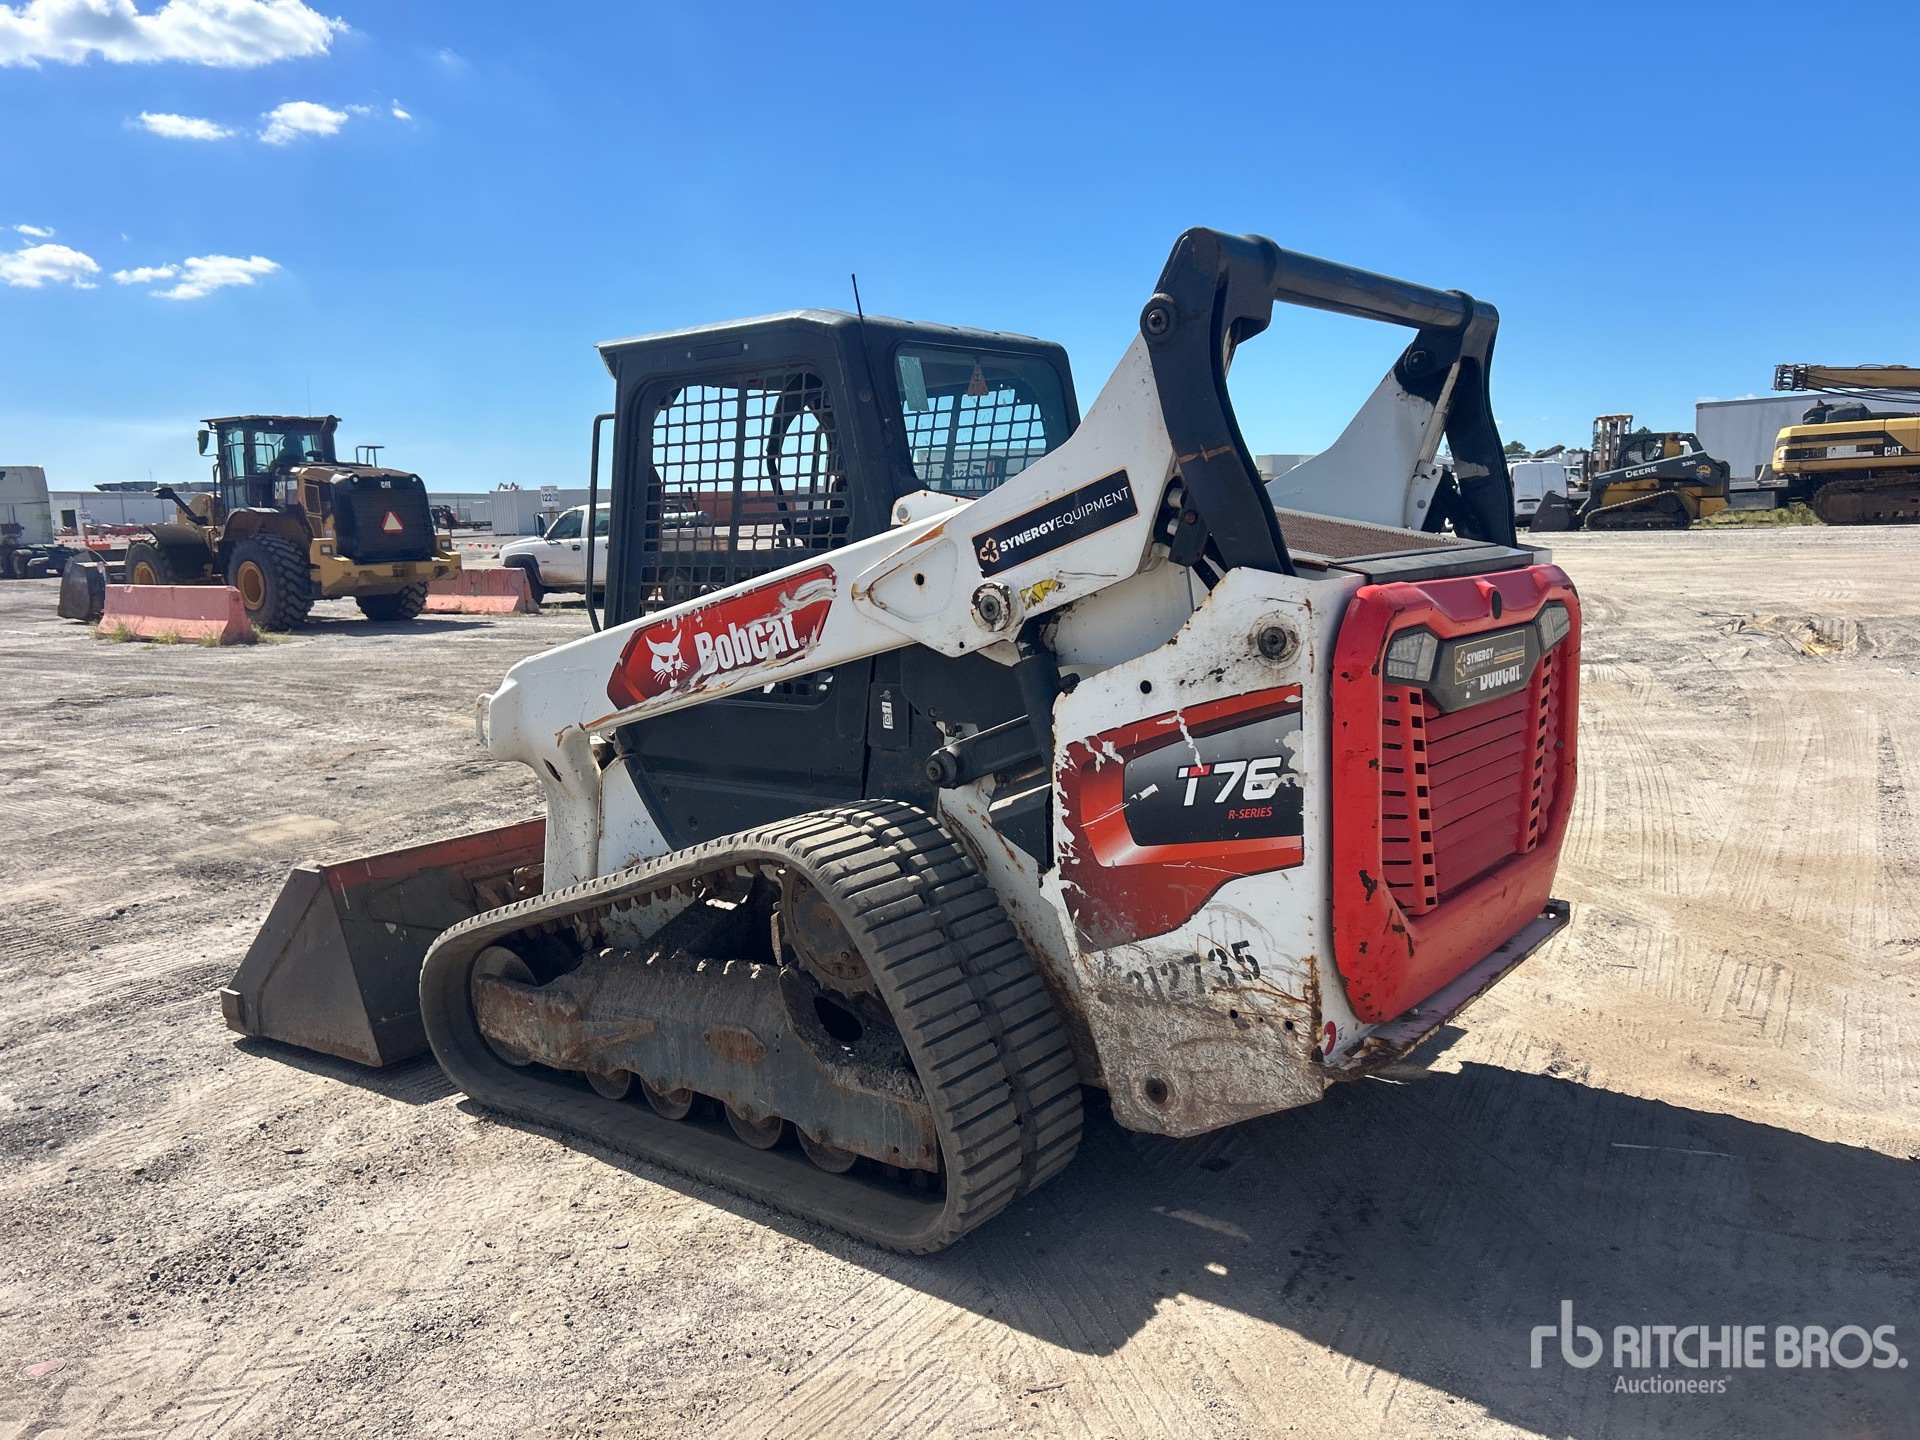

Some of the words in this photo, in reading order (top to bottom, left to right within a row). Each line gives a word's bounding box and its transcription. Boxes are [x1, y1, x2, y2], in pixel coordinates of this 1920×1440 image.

[1884, 446, 1903, 457] CAT
[1625, 465, 1658, 478] DEERE
[274, 481, 286, 499] CAT
[380, 480, 391, 489] CAT
[541, 493, 552, 501] 122
[694, 613, 800, 676] Bobcat
[1466, 647, 1495, 666] SYNERGY
[1228, 806, 1273, 820] R-SERIES
